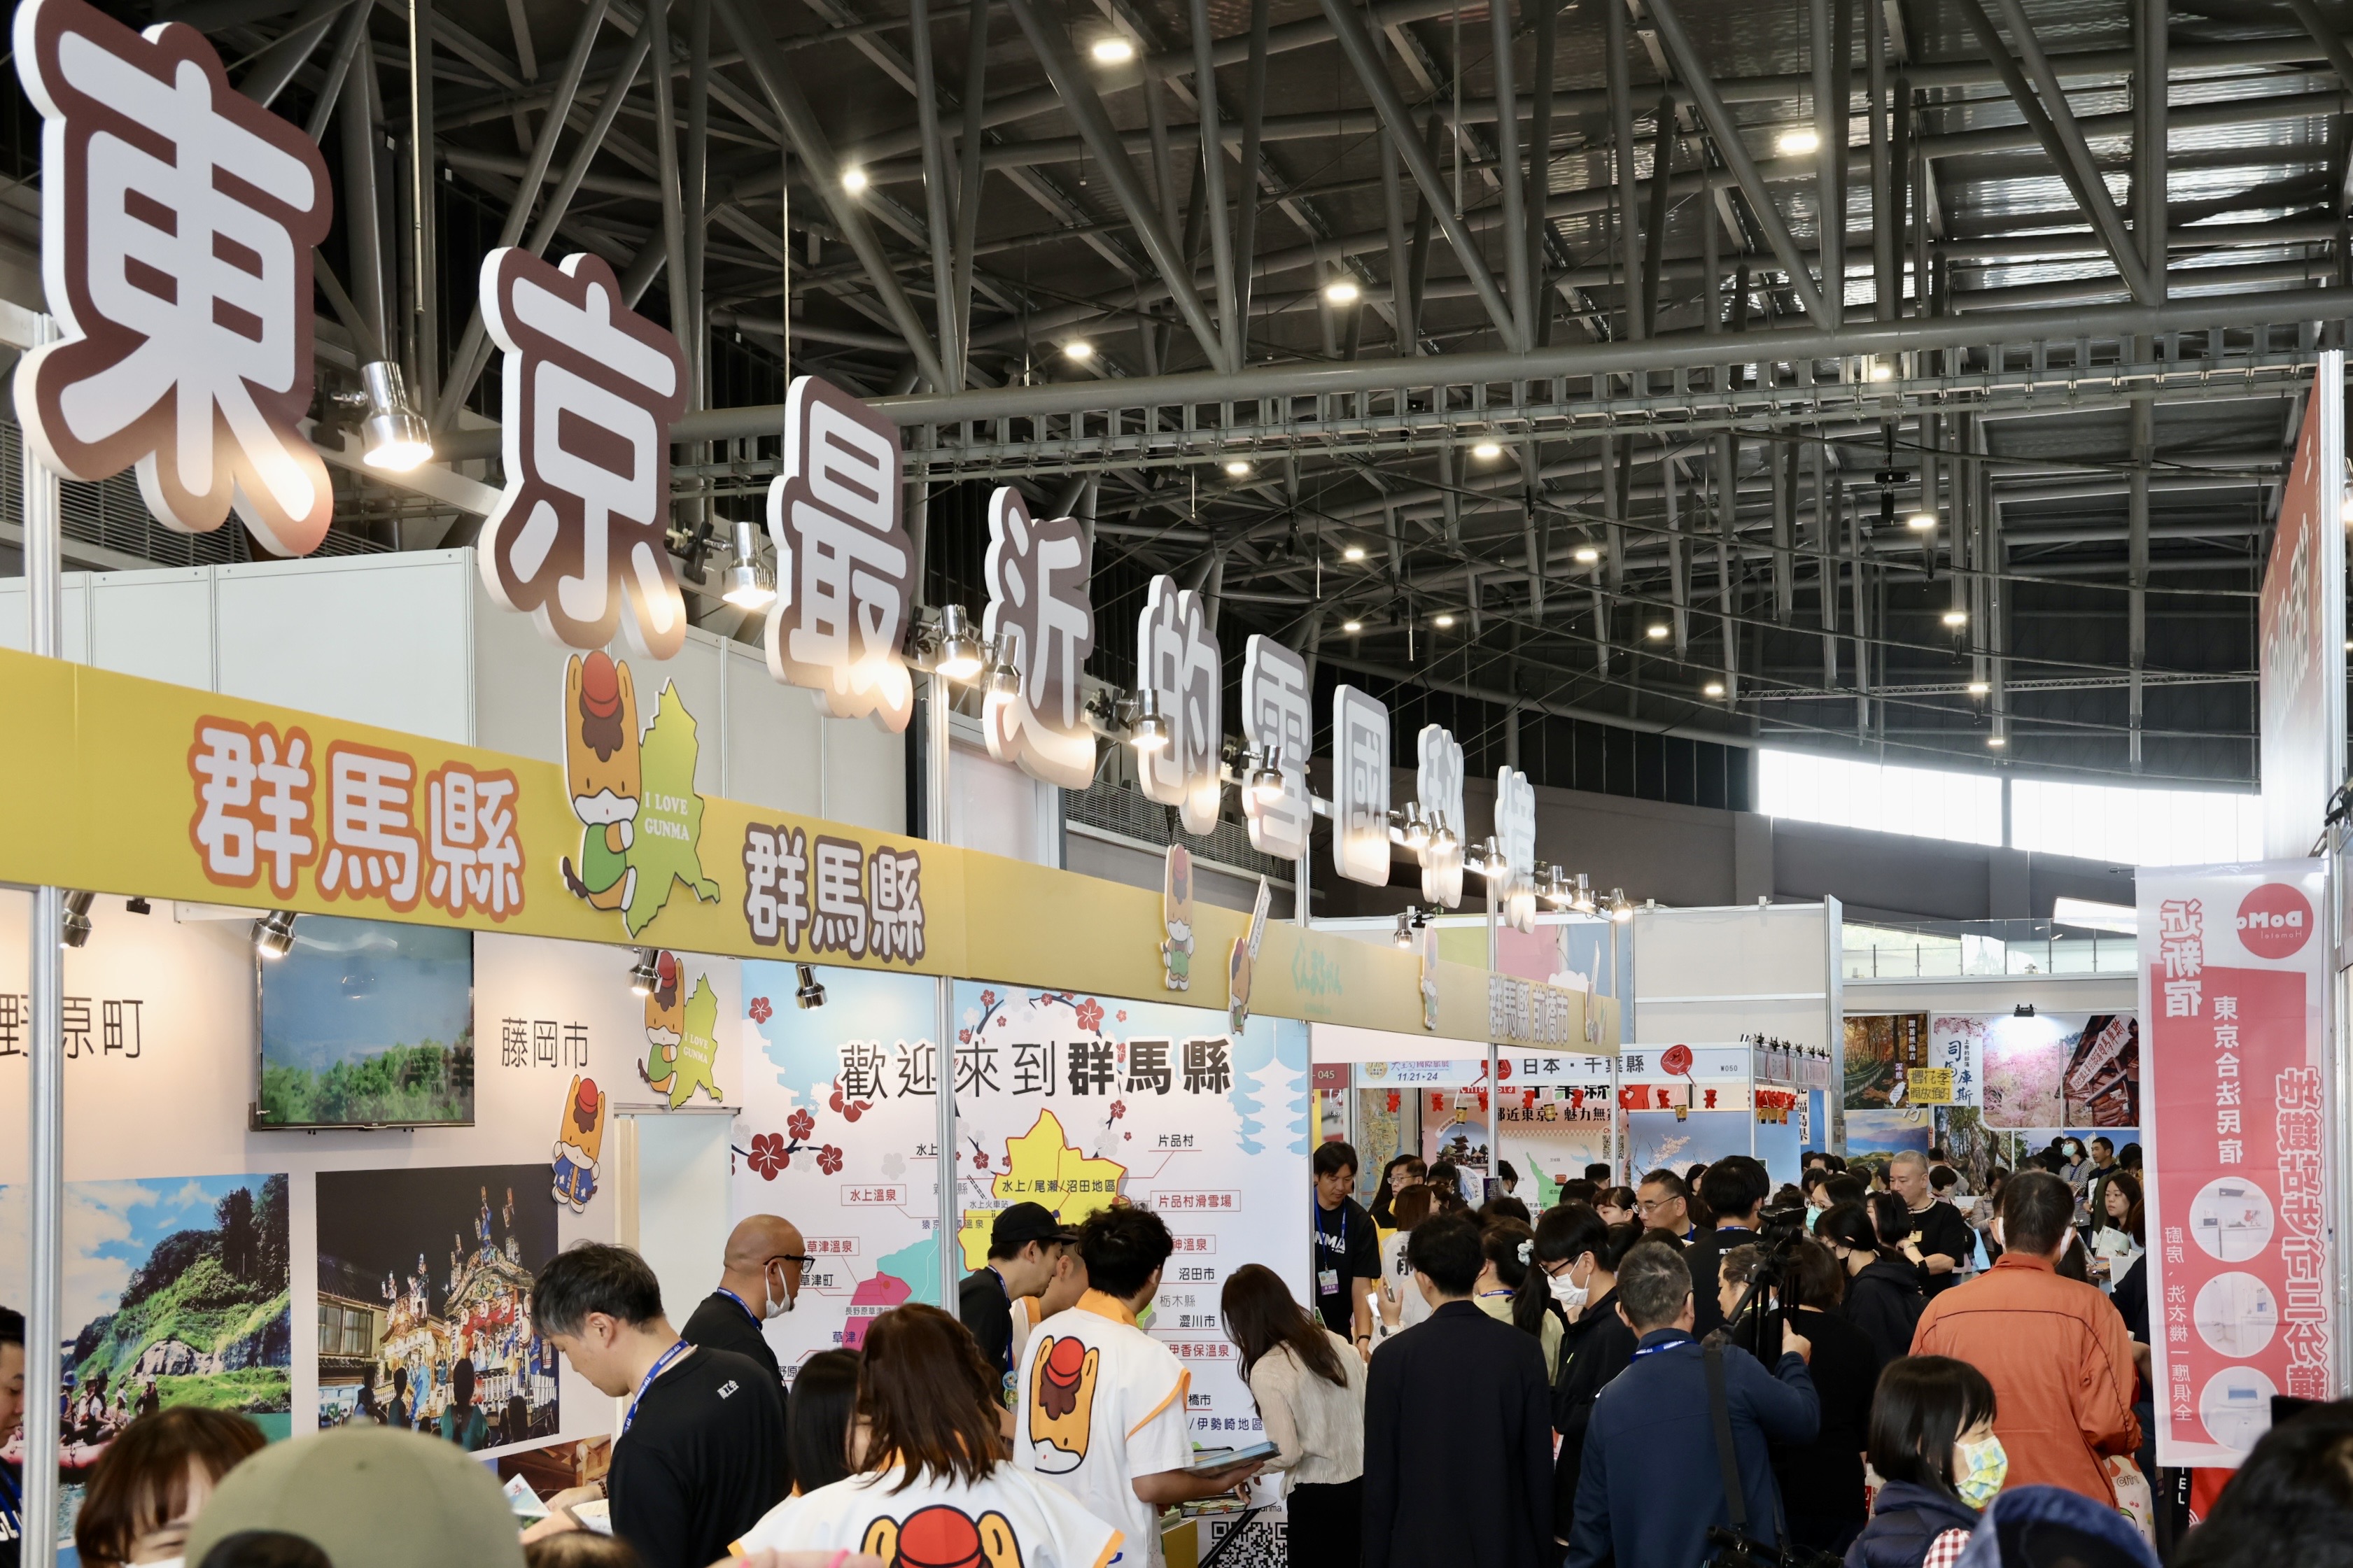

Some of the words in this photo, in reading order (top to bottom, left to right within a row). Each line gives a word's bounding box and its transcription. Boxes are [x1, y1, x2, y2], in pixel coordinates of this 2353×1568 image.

[645, 792, 651, 809] I
[655, 794, 689, 816] LOVE
[188, 714, 525, 922] 群馬縣
[644, 820, 690, 841] GUNMA
[743, 822, 925, 966] 群馬縣
[1489, 975, 1530, 1041] 群馬縣
[1533, 983, 1568, 1046] 前橋市
[502, 1017, 589, 1068] 藤岡市
[689, 1034, 709, 1050] LOVE
[683, 1047, 709, 1064] GUNMA
[841, 1038, 1232, 1101] 歡迎來到群馬縣
[1318, 1071, 1335, 1079] 045
[1911, 1070, 1951, 1085] 櫻花季
[1158, 1134, 1194, 1147] 片品村
[850, 1189, 897, 1201] 水上溫泉
[1158, 1194, 1232, 1208] 片品村滑雪場
[969, 1200, 1009, 1209] 水上火車站
[807, 1241, 852, 1253] 草津溫泉
[800, 1274, 834, 1287] 草津町
[1179, 1267, 1215, 1280] 沼田市
[1160, 1294, 1195, 1307] 栃木縣
[1170, 1344, 1229, 1357] 伊香保溫泉
